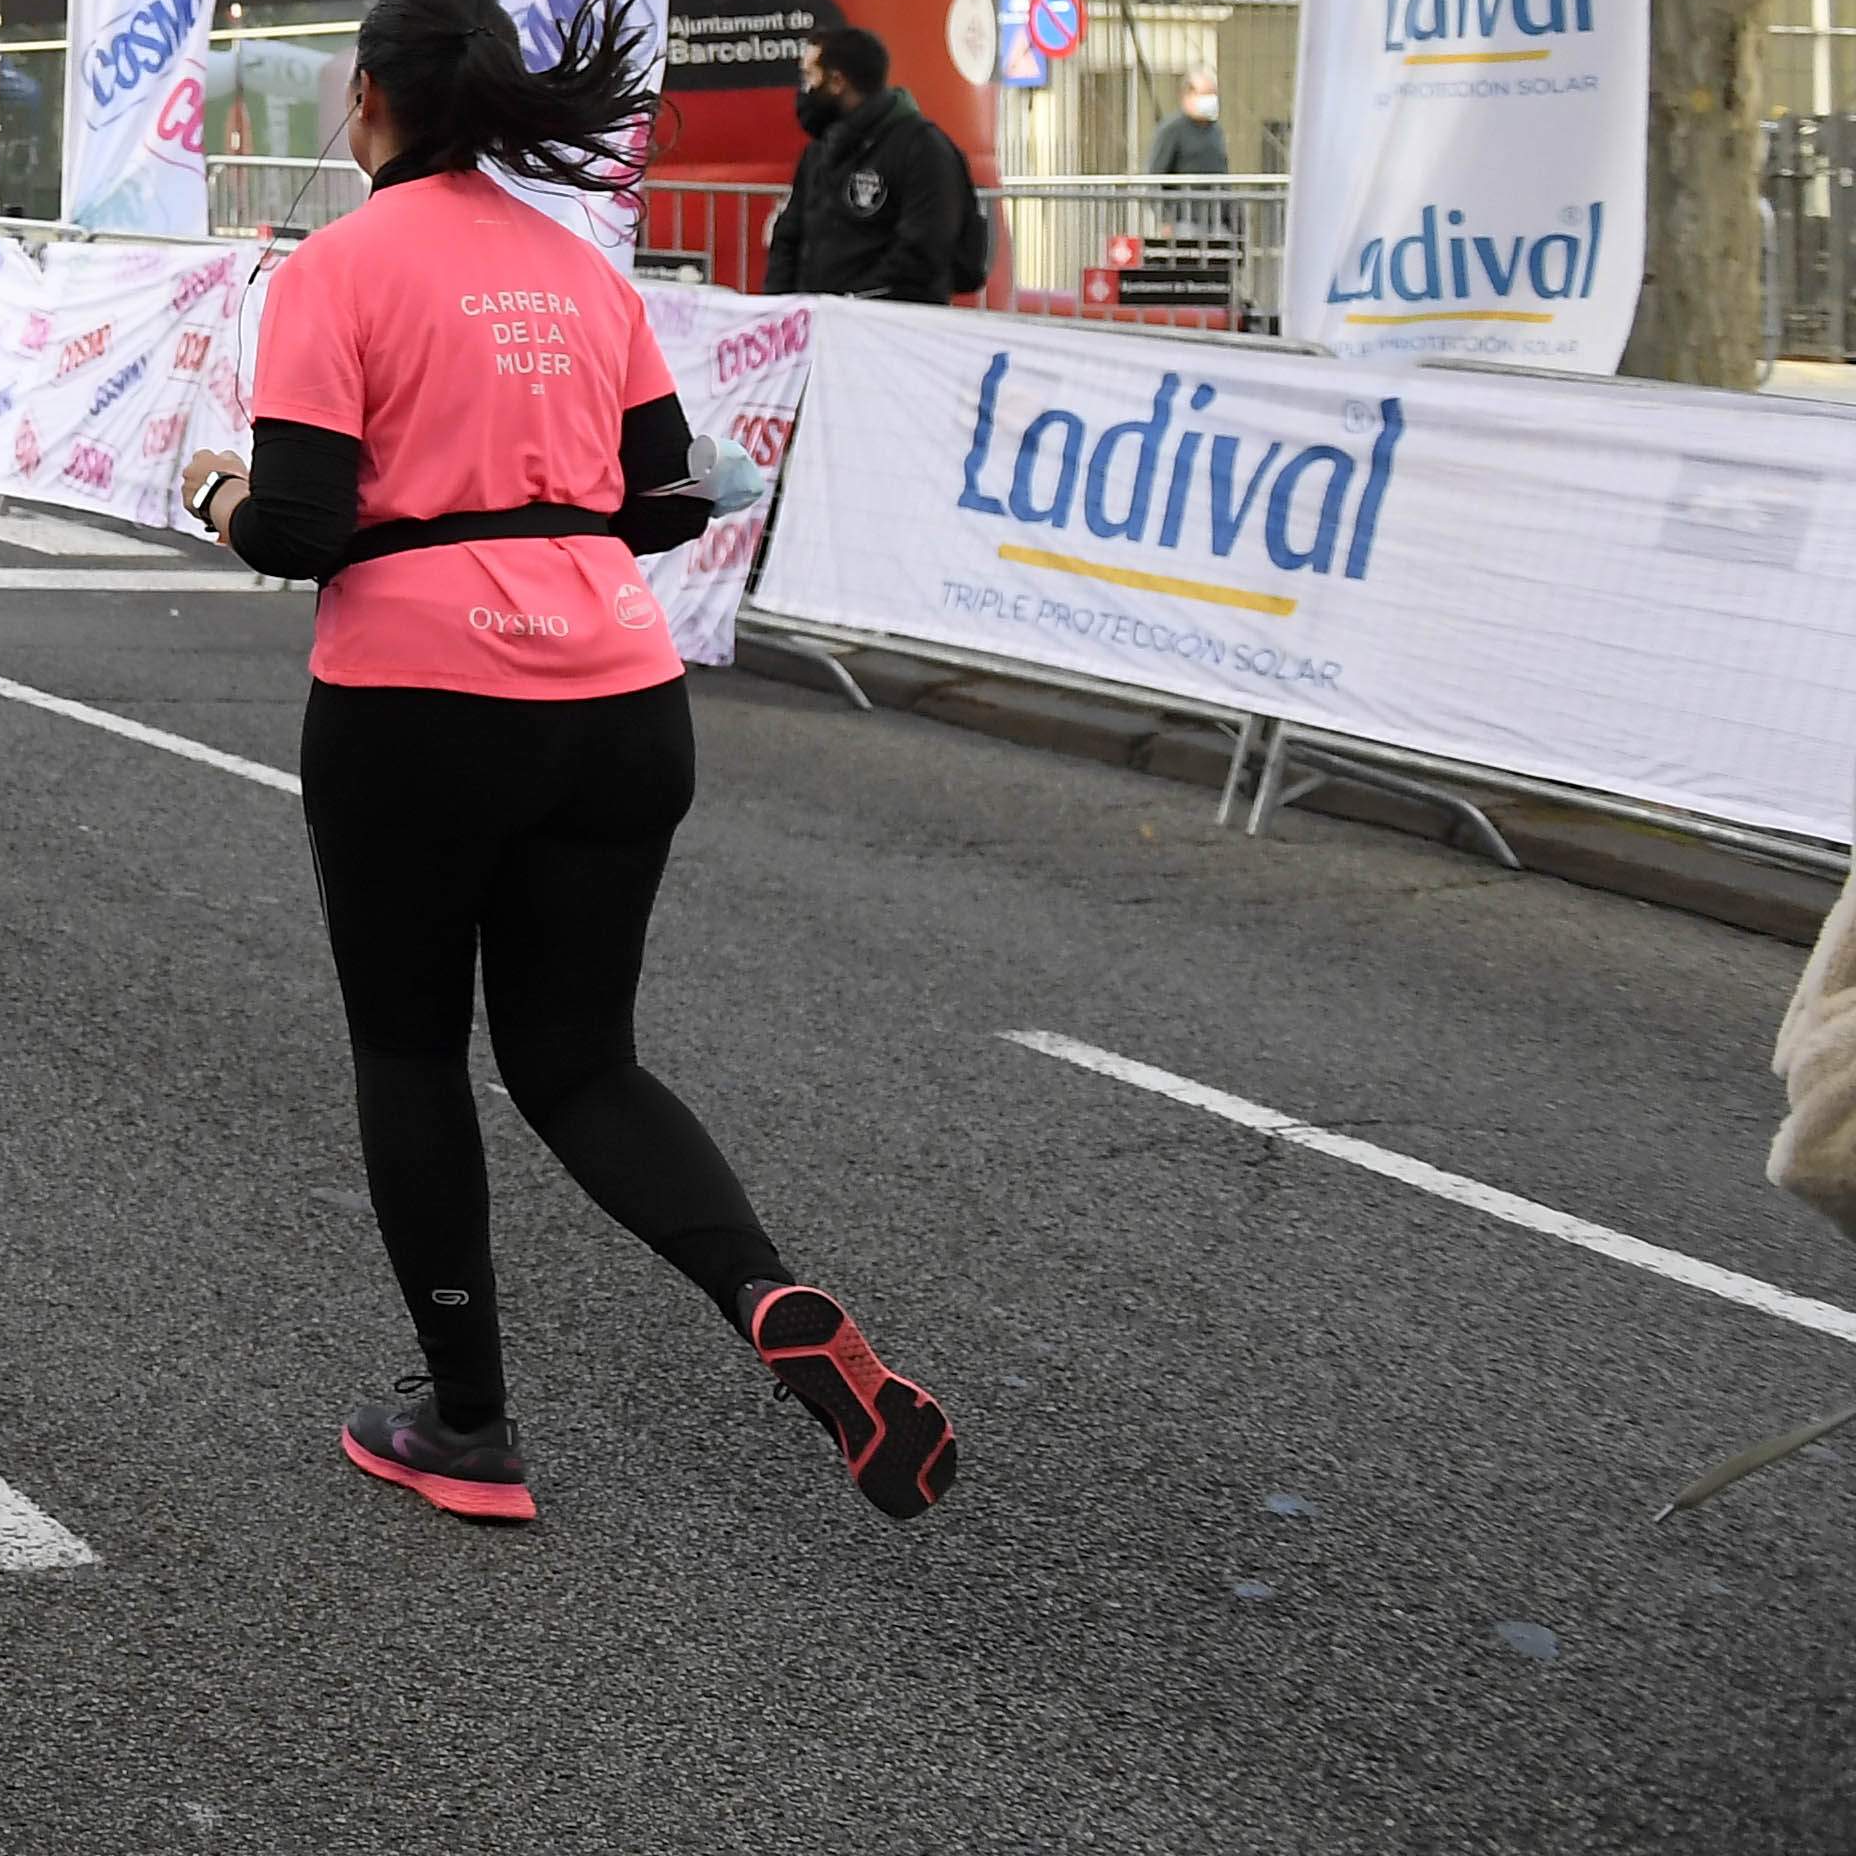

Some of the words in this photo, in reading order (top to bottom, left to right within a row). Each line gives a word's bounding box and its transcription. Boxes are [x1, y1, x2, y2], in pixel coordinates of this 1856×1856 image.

[461, 290, 580, 318] CARRERA
[492, 321, 529, 344] DE
[533, 321, 566, 345] LA
[957, 351, 1408, 582] Ladival
[469, 605, 570, 639] OYSHO
[941, 579, 1032, 624] TRIPLE
[1232, 644, 1344, 692] SOLAR
